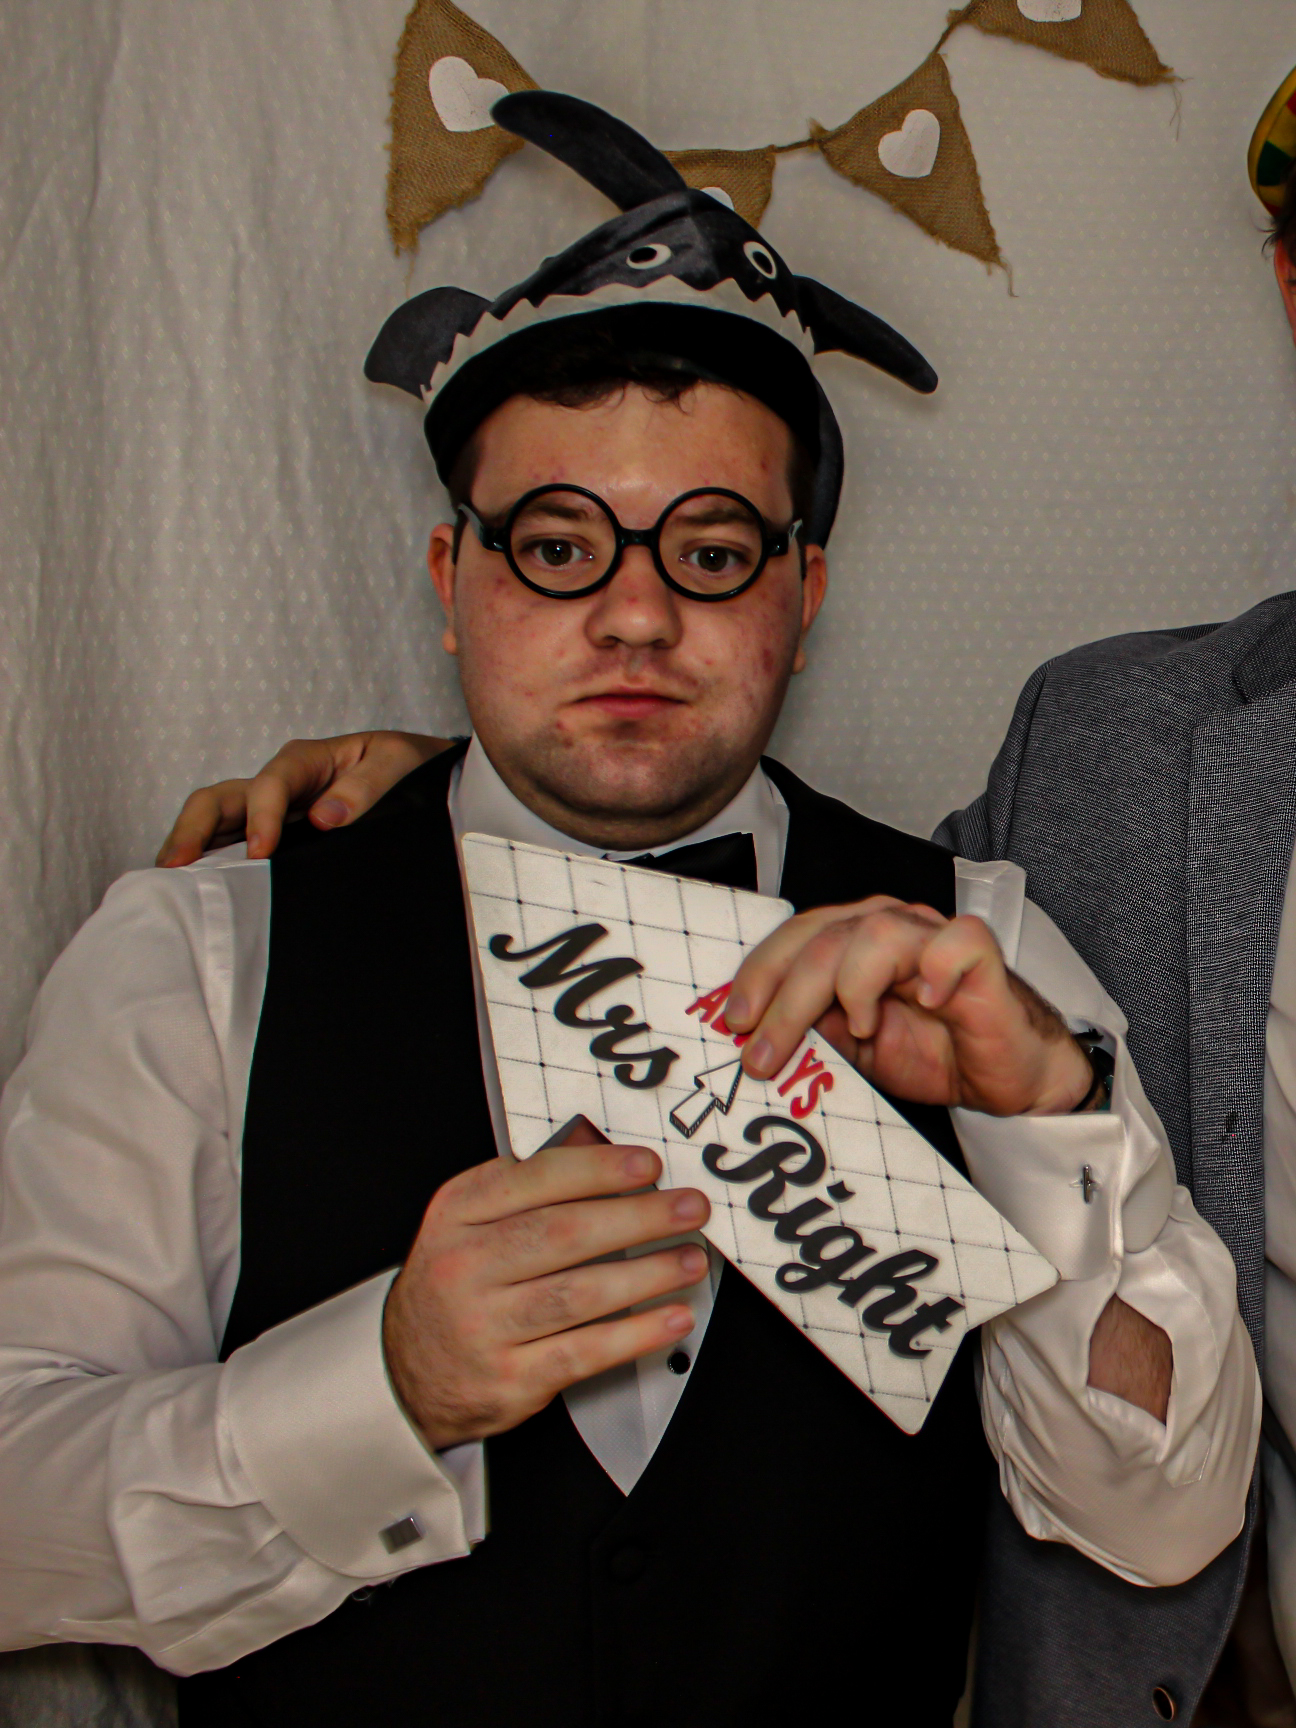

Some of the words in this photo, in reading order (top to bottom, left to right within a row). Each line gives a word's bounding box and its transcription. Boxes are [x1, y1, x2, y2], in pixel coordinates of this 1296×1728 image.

[489, 923, 680, 1090] Mrs
[702, 1115, 965, 1360] Right
[685, 981, 833, 1119] AYS
